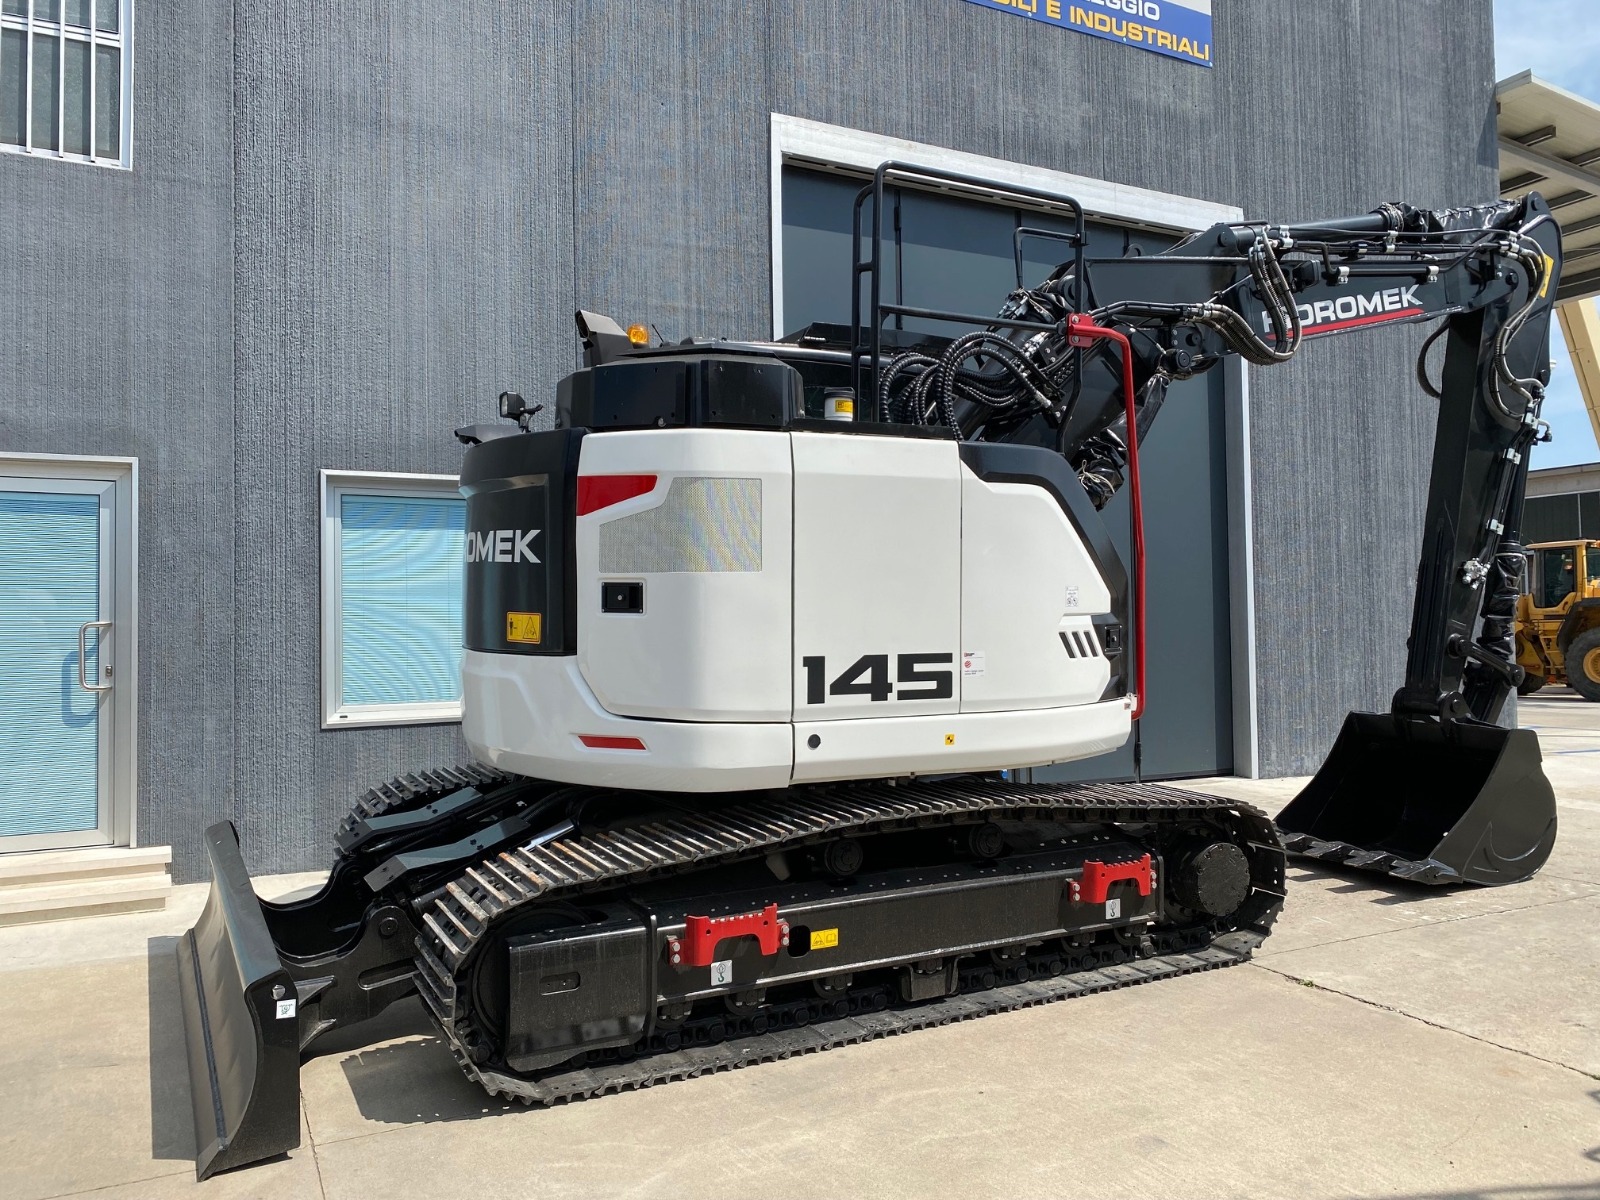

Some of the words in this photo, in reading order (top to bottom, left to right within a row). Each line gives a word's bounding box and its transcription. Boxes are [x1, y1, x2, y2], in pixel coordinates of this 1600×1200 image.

[1046, 0, 1061, 20] E
[1070, 5, 1209, 61] INDUSTRIALI
[464, 529, 542, 564] OMEK
[803, 652, 953, 704] 145
